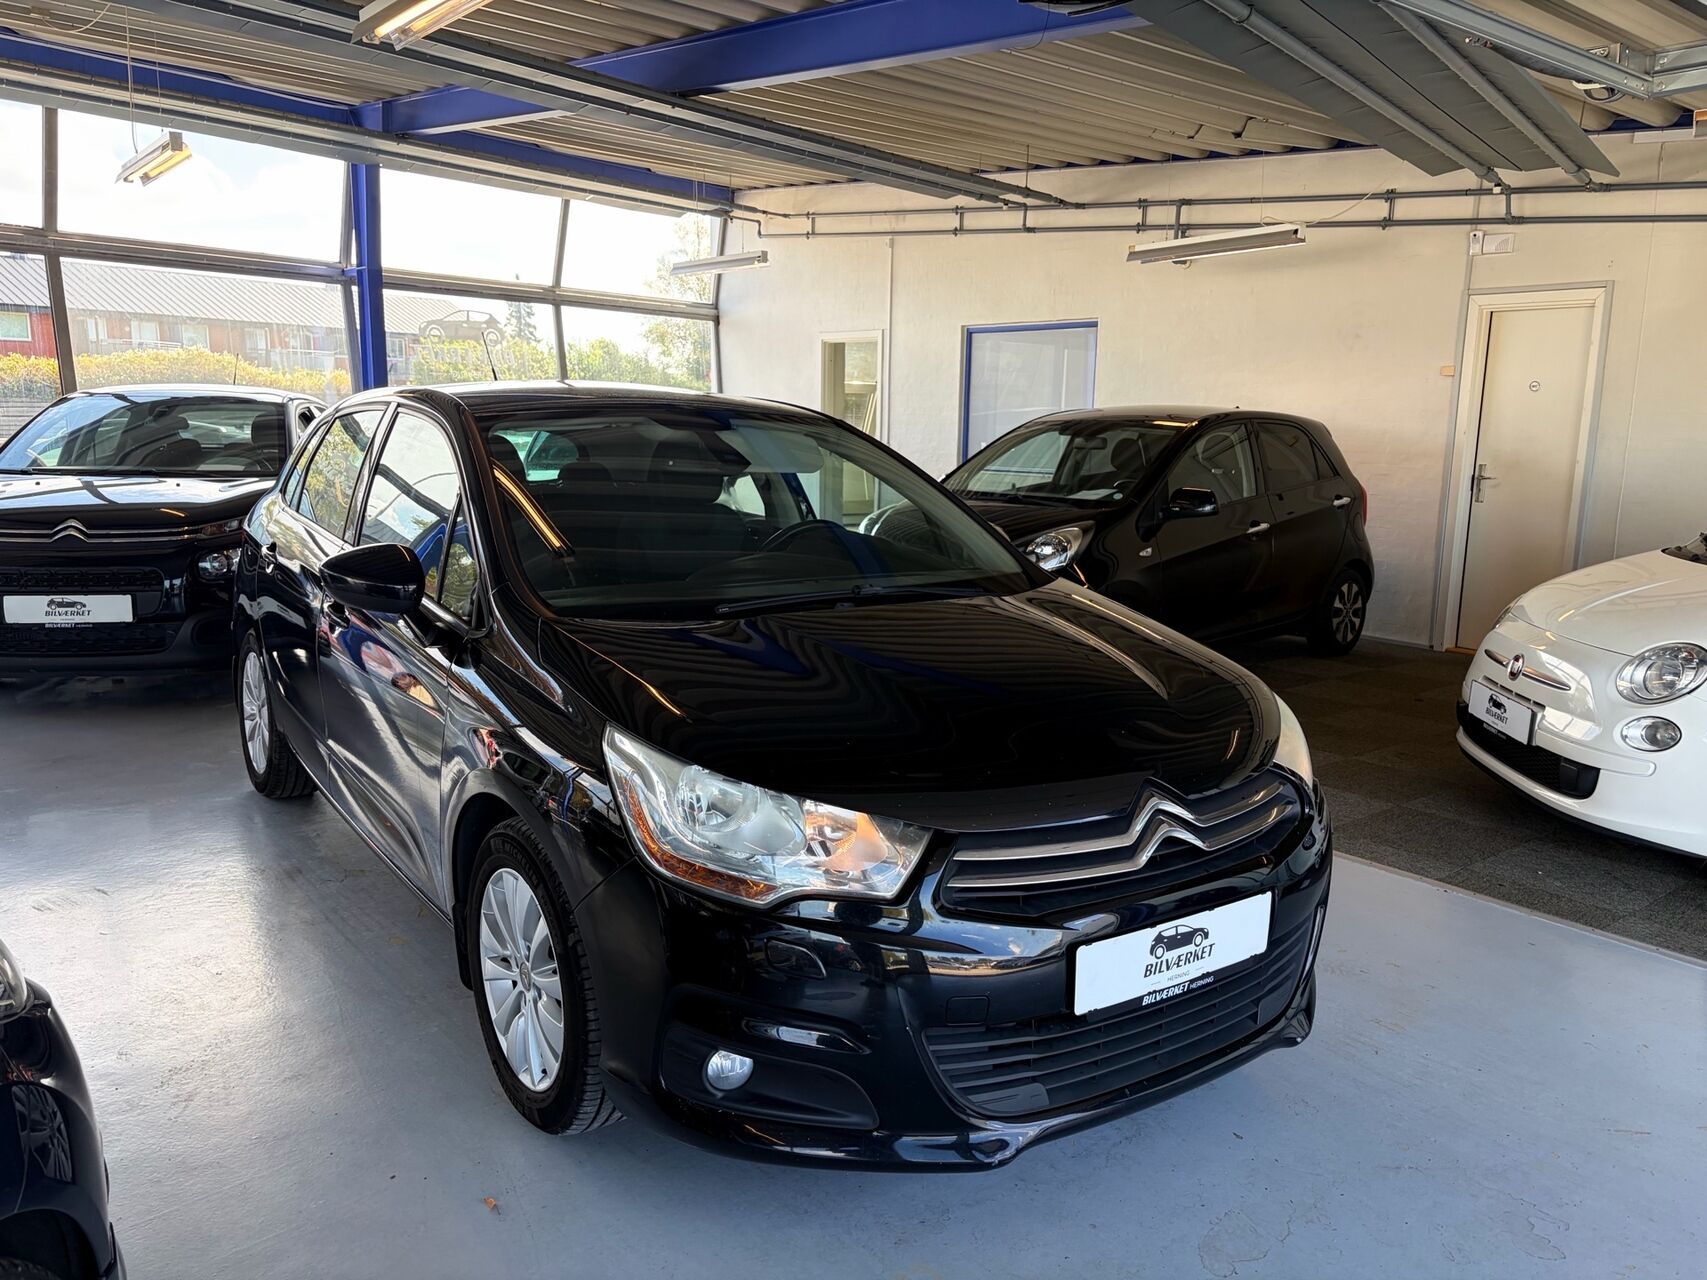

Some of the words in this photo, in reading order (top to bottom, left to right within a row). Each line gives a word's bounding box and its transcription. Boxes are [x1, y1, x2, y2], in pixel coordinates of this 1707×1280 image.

[45, 609, 91, 617] BILVÆRKET
[1143, 943, 1215, 979] BILVÆRKET
[1167, 970, 1190, 982] HERNING
[1142, 981, 1190, 1006] BILVÆRKET
[1189, 975, 1215, 990] HERNING
